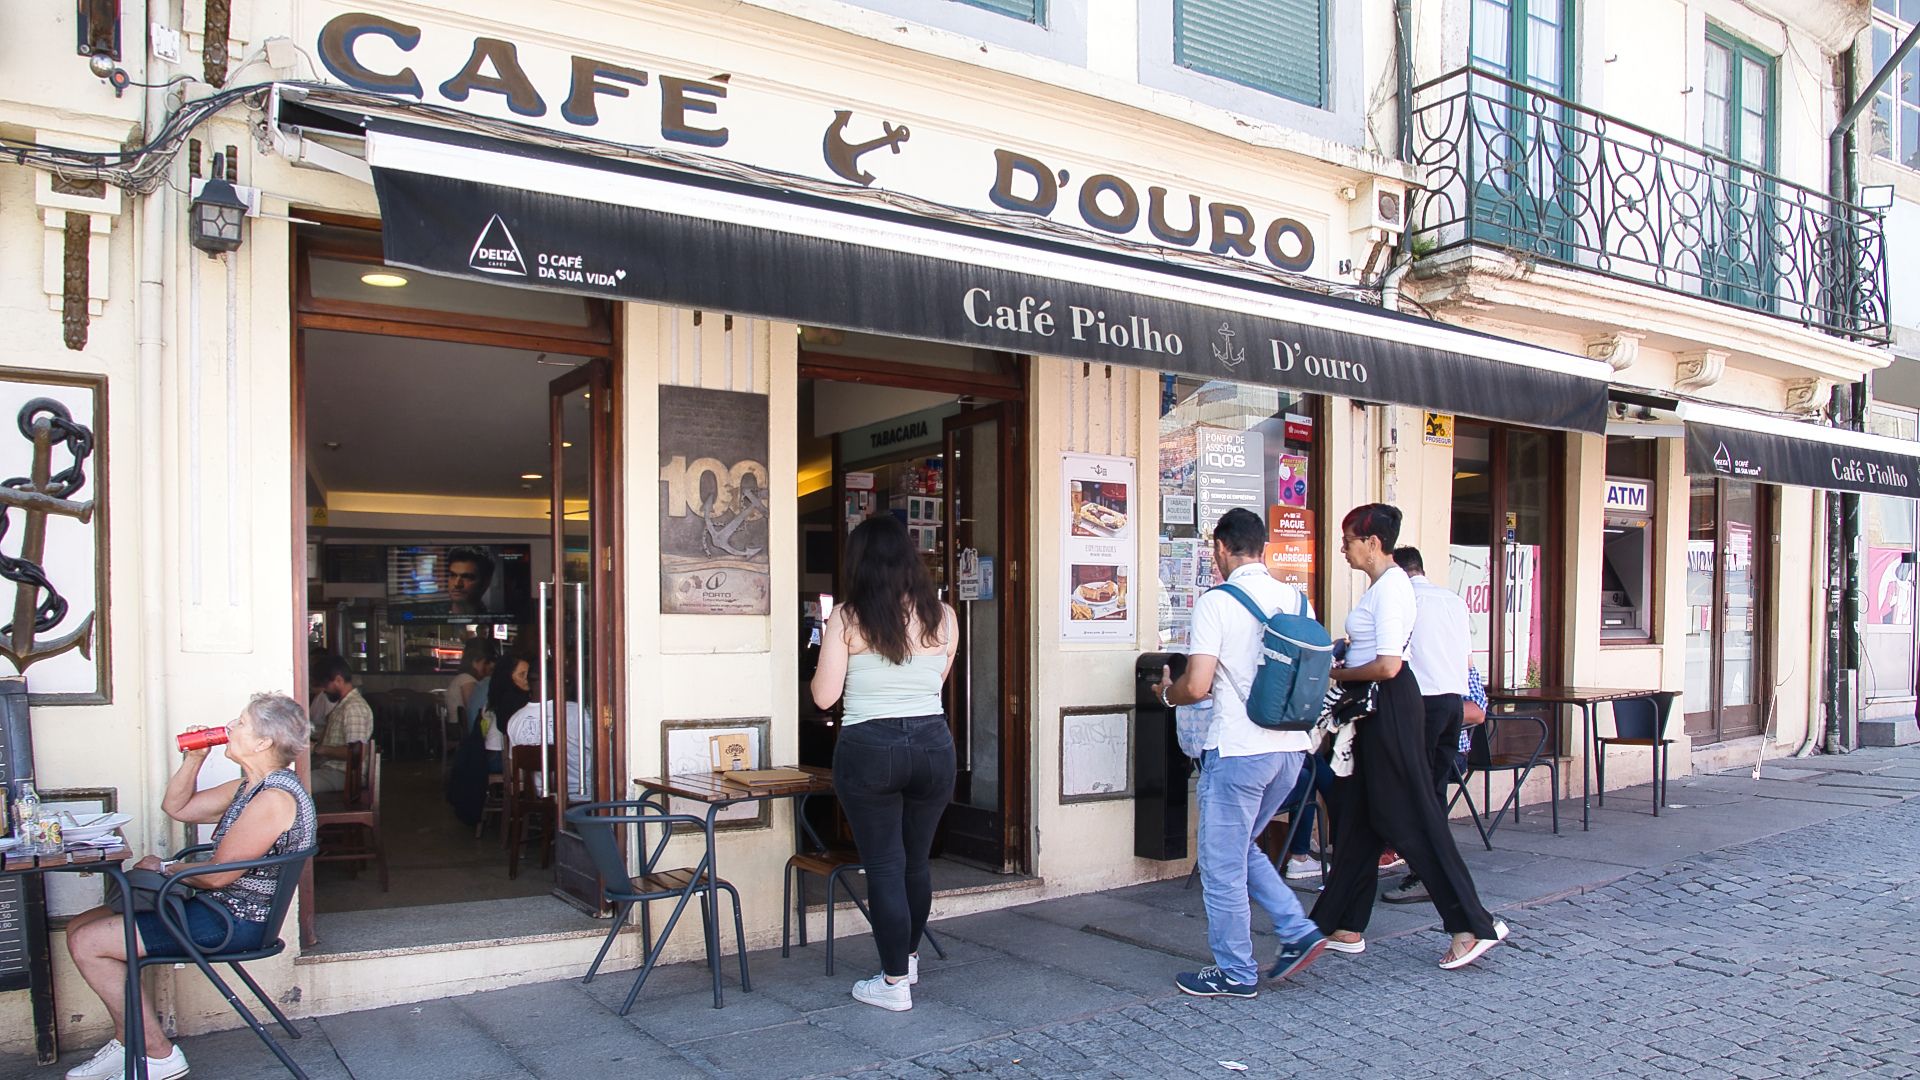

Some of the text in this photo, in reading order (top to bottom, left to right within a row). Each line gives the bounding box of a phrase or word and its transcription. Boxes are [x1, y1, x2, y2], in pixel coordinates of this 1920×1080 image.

[317, 12, 1315, 272] CAFÉ D'OURO
[538, 254, 583, 269] O CAFÉ
[538, 267, 617, 287] DA SUA VIDA
[963, 286, 1369, 385] Café Piolho D'ouro
[870, 421, 929, 449] TABACARIA
[1205, 433, 1246, 445] PONTO DE
[1425, 436, 1452, 445] PROSEGUR
[1205, 452, 1246, 469] IQOS
[1831, 457, 1909, 488] Café Piolho
[1606, 485, 1645, 506] ATM
[1279, 519, 1306, 530] PAGUE
[1272, 552, 1313, 563] CARREGUE
